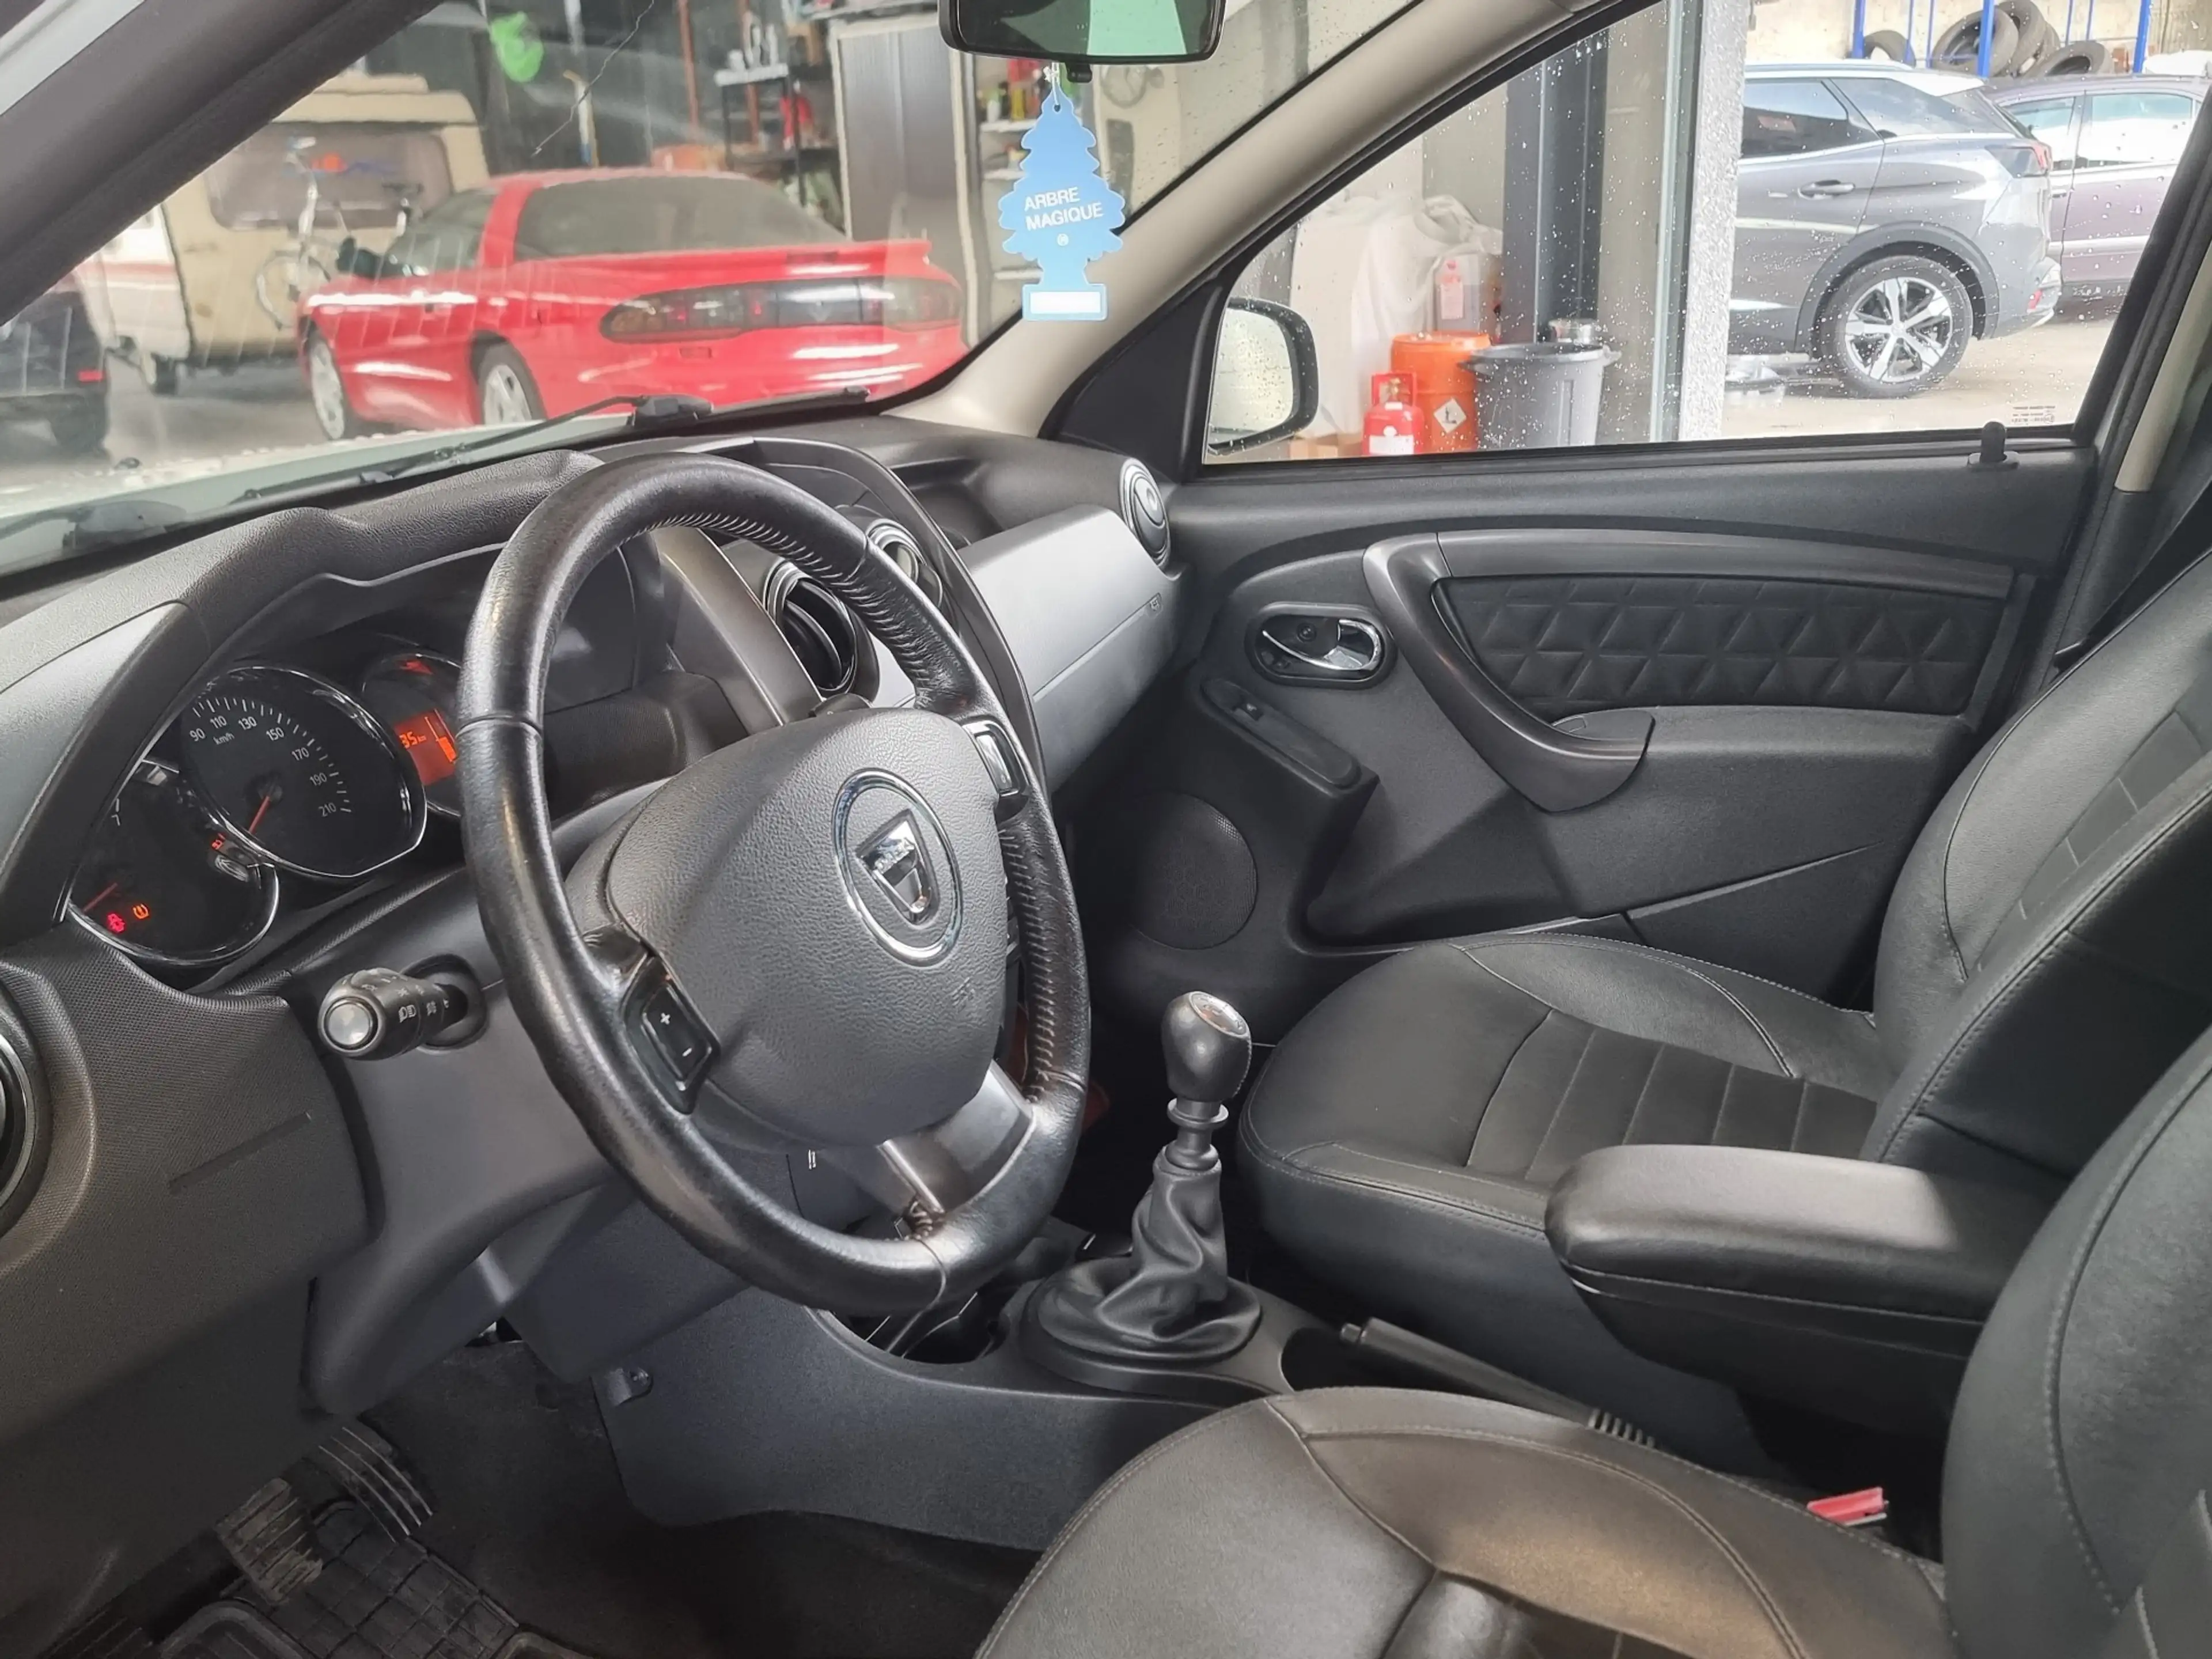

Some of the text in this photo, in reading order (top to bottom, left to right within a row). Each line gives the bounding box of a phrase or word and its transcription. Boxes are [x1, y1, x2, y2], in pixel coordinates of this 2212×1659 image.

[1024, 187, 1081, 211] ARBRE
[1025, 202, 1104, 231] MAGIQUE
[210, 715, 227, 729] 110
[238, 716, 257, 730] 130
[189, 728, 206, 742] 90
[213, 732, 234, 745] km/h
[266, 727, 285, 741] 150
[291, 747, 310, 761] 170
[309, 772, 327, 786] 190
[318, 802, 336, 817] 210
